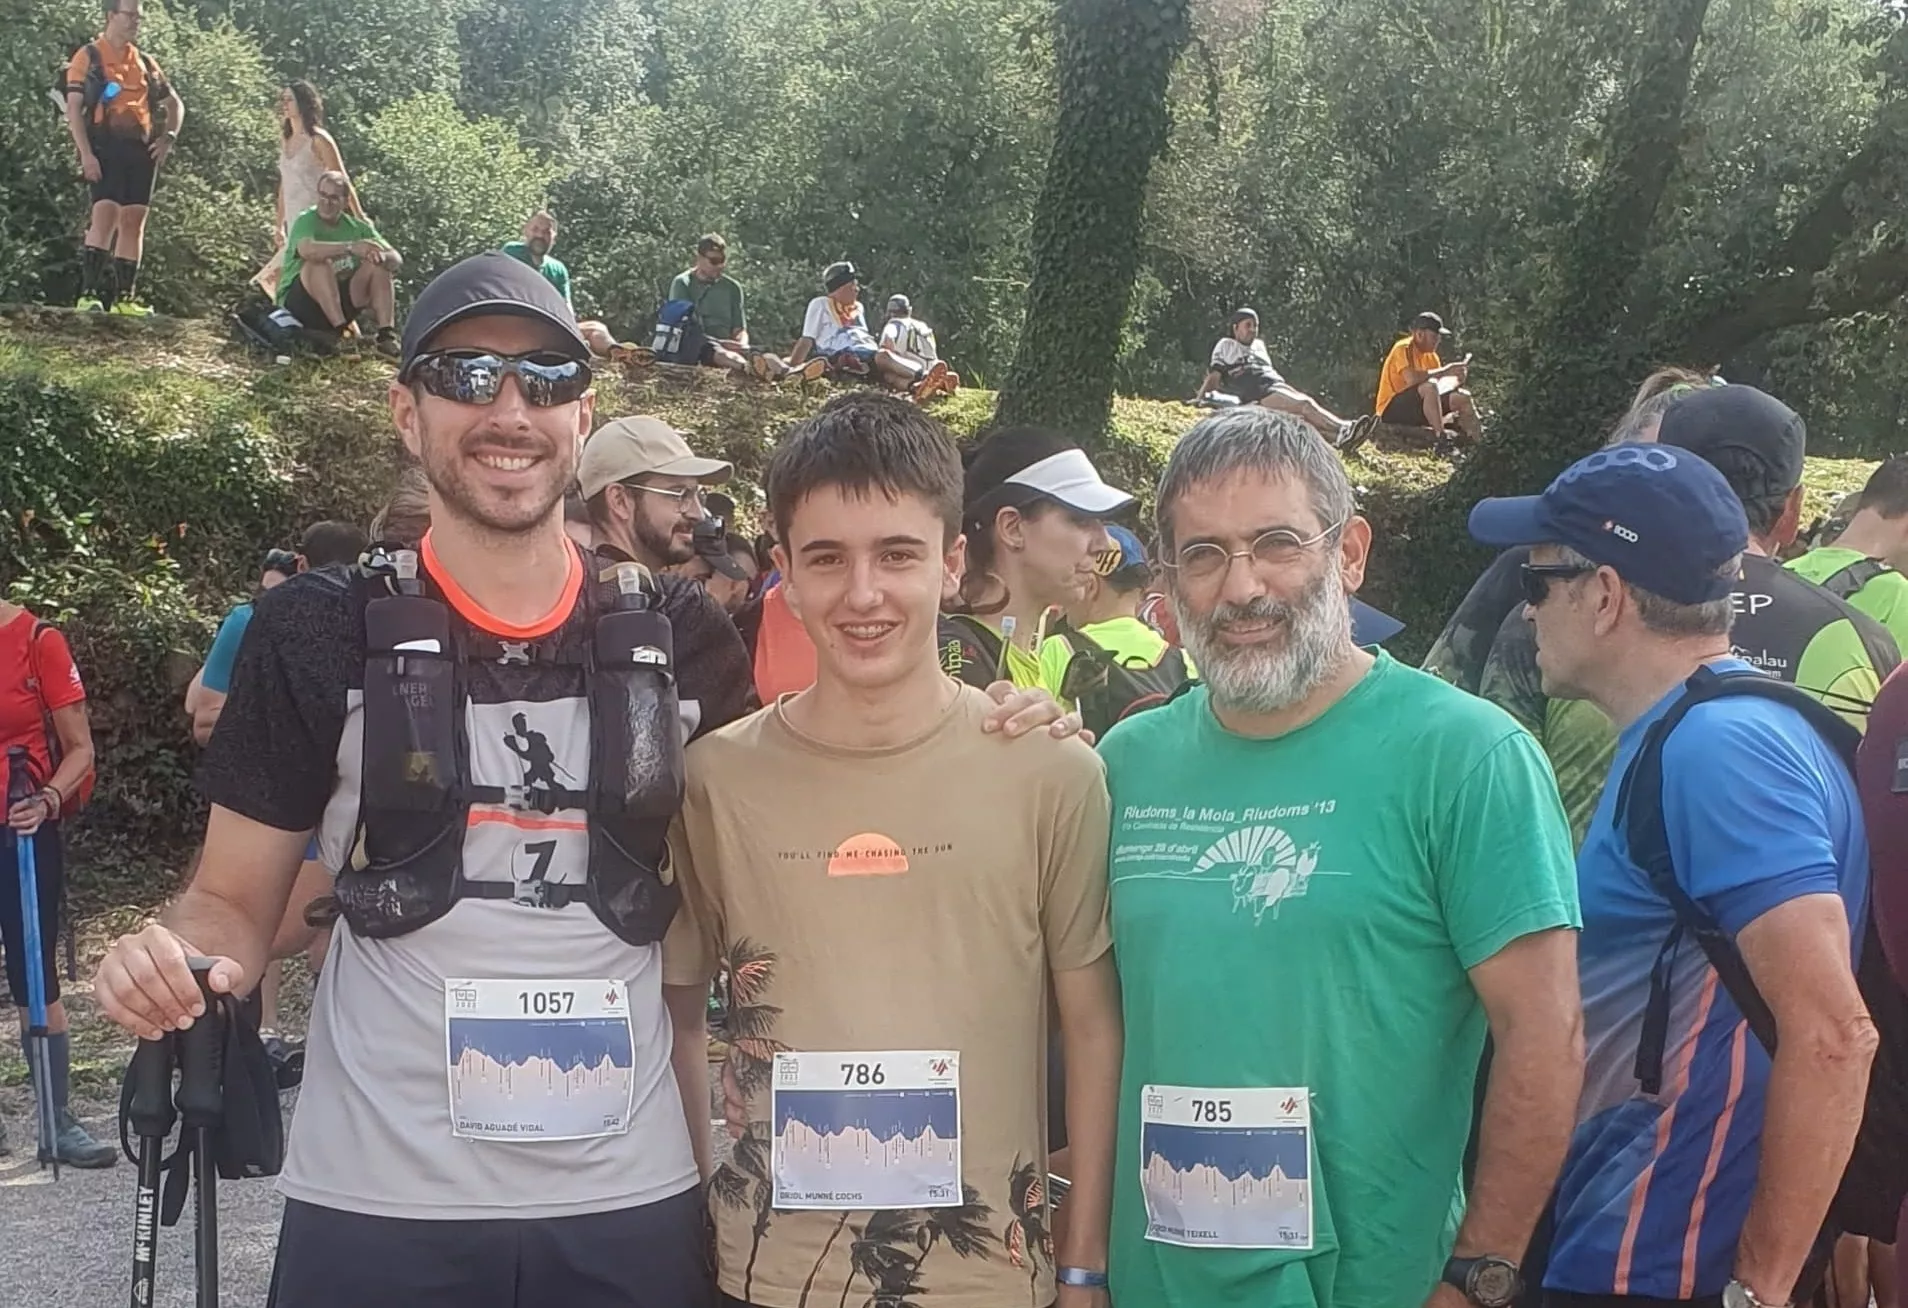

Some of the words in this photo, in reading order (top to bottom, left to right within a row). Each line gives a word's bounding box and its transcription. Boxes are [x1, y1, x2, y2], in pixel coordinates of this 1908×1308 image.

[524, 839, 557, 882] 7
[817, 852, 840, 860] FIND
[865, 850, 906, 859] CHASING
[912, 847, 928, 856] THE
[934, 844, 953, 853] SUN
[518, 991, 575, 1015] 1057
[840, 1063, 885, 1086] 786
[1191, 1100, 1232, 1122] 785
[459, 1121, 483, 1131] DAVID
